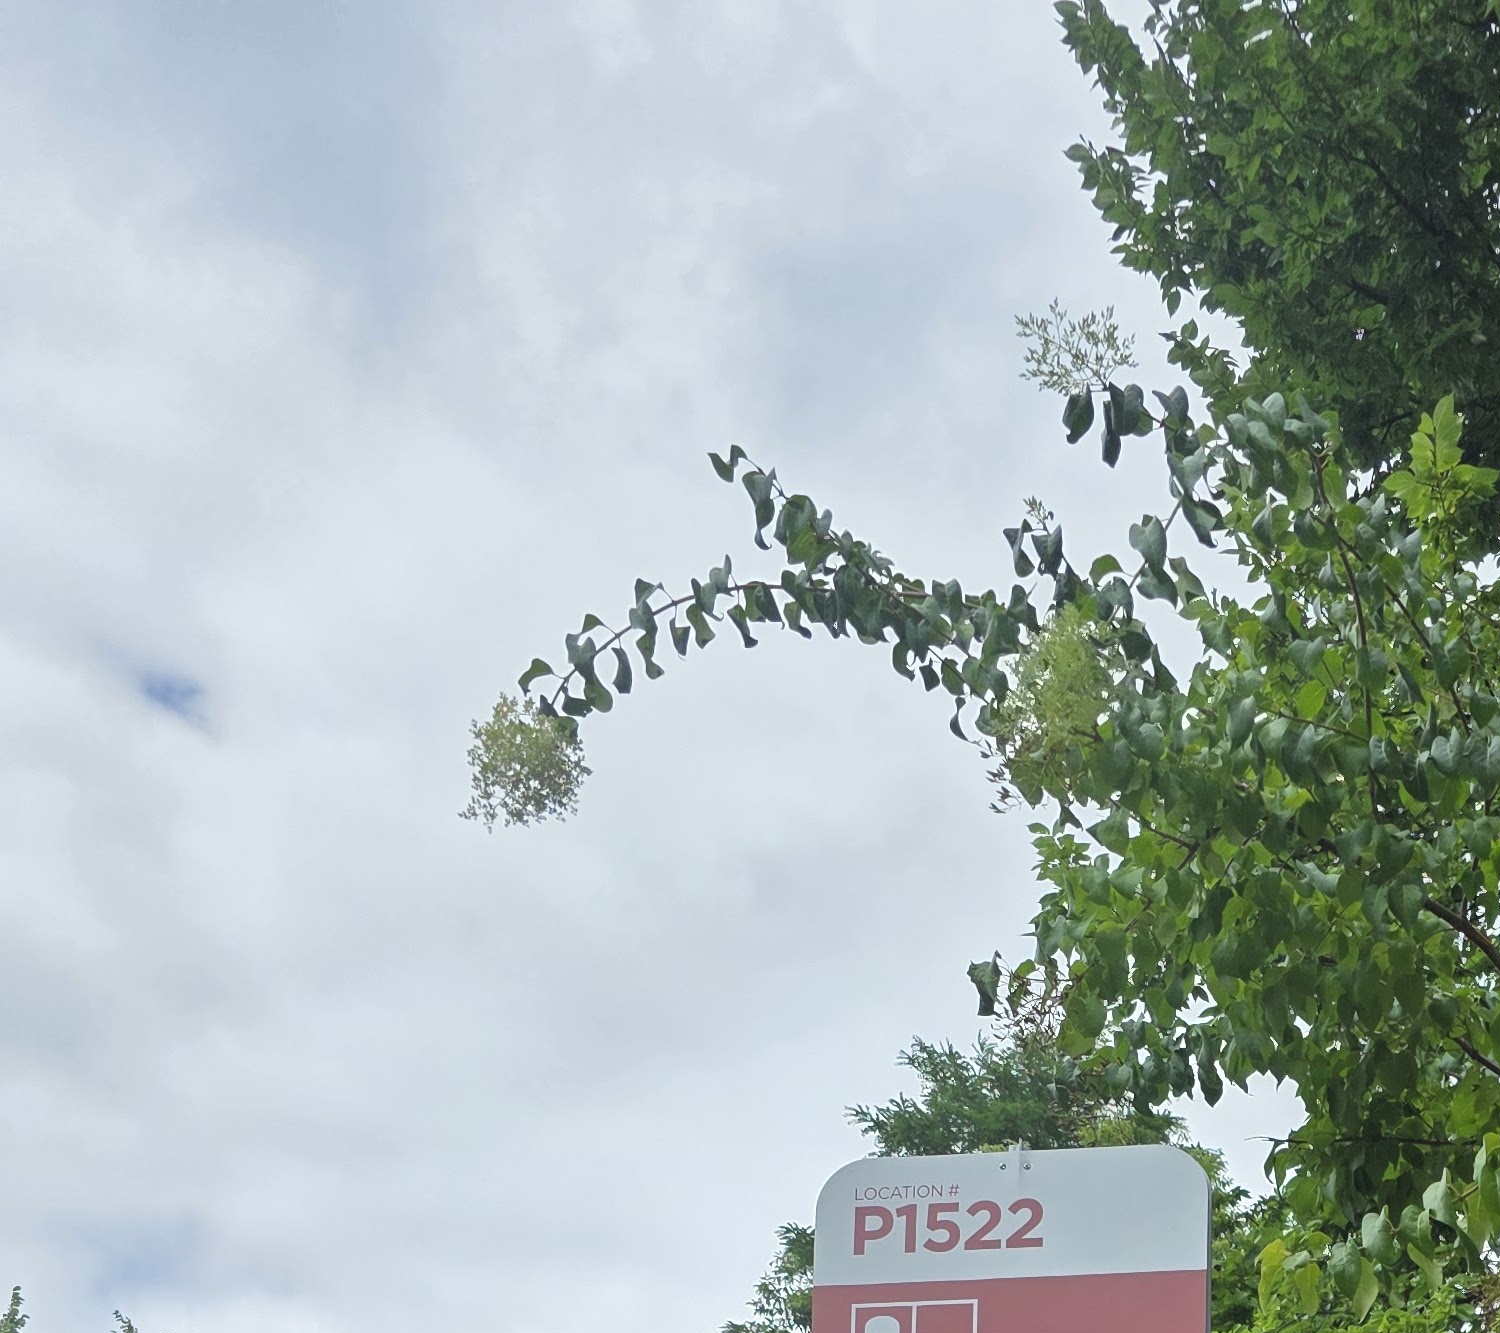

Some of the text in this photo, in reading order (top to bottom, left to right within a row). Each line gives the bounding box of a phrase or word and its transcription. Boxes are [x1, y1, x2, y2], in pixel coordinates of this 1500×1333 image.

[855, 1184, 960, 1200] LOCATION #
[854, 1195, 1043, 1255] P1522
